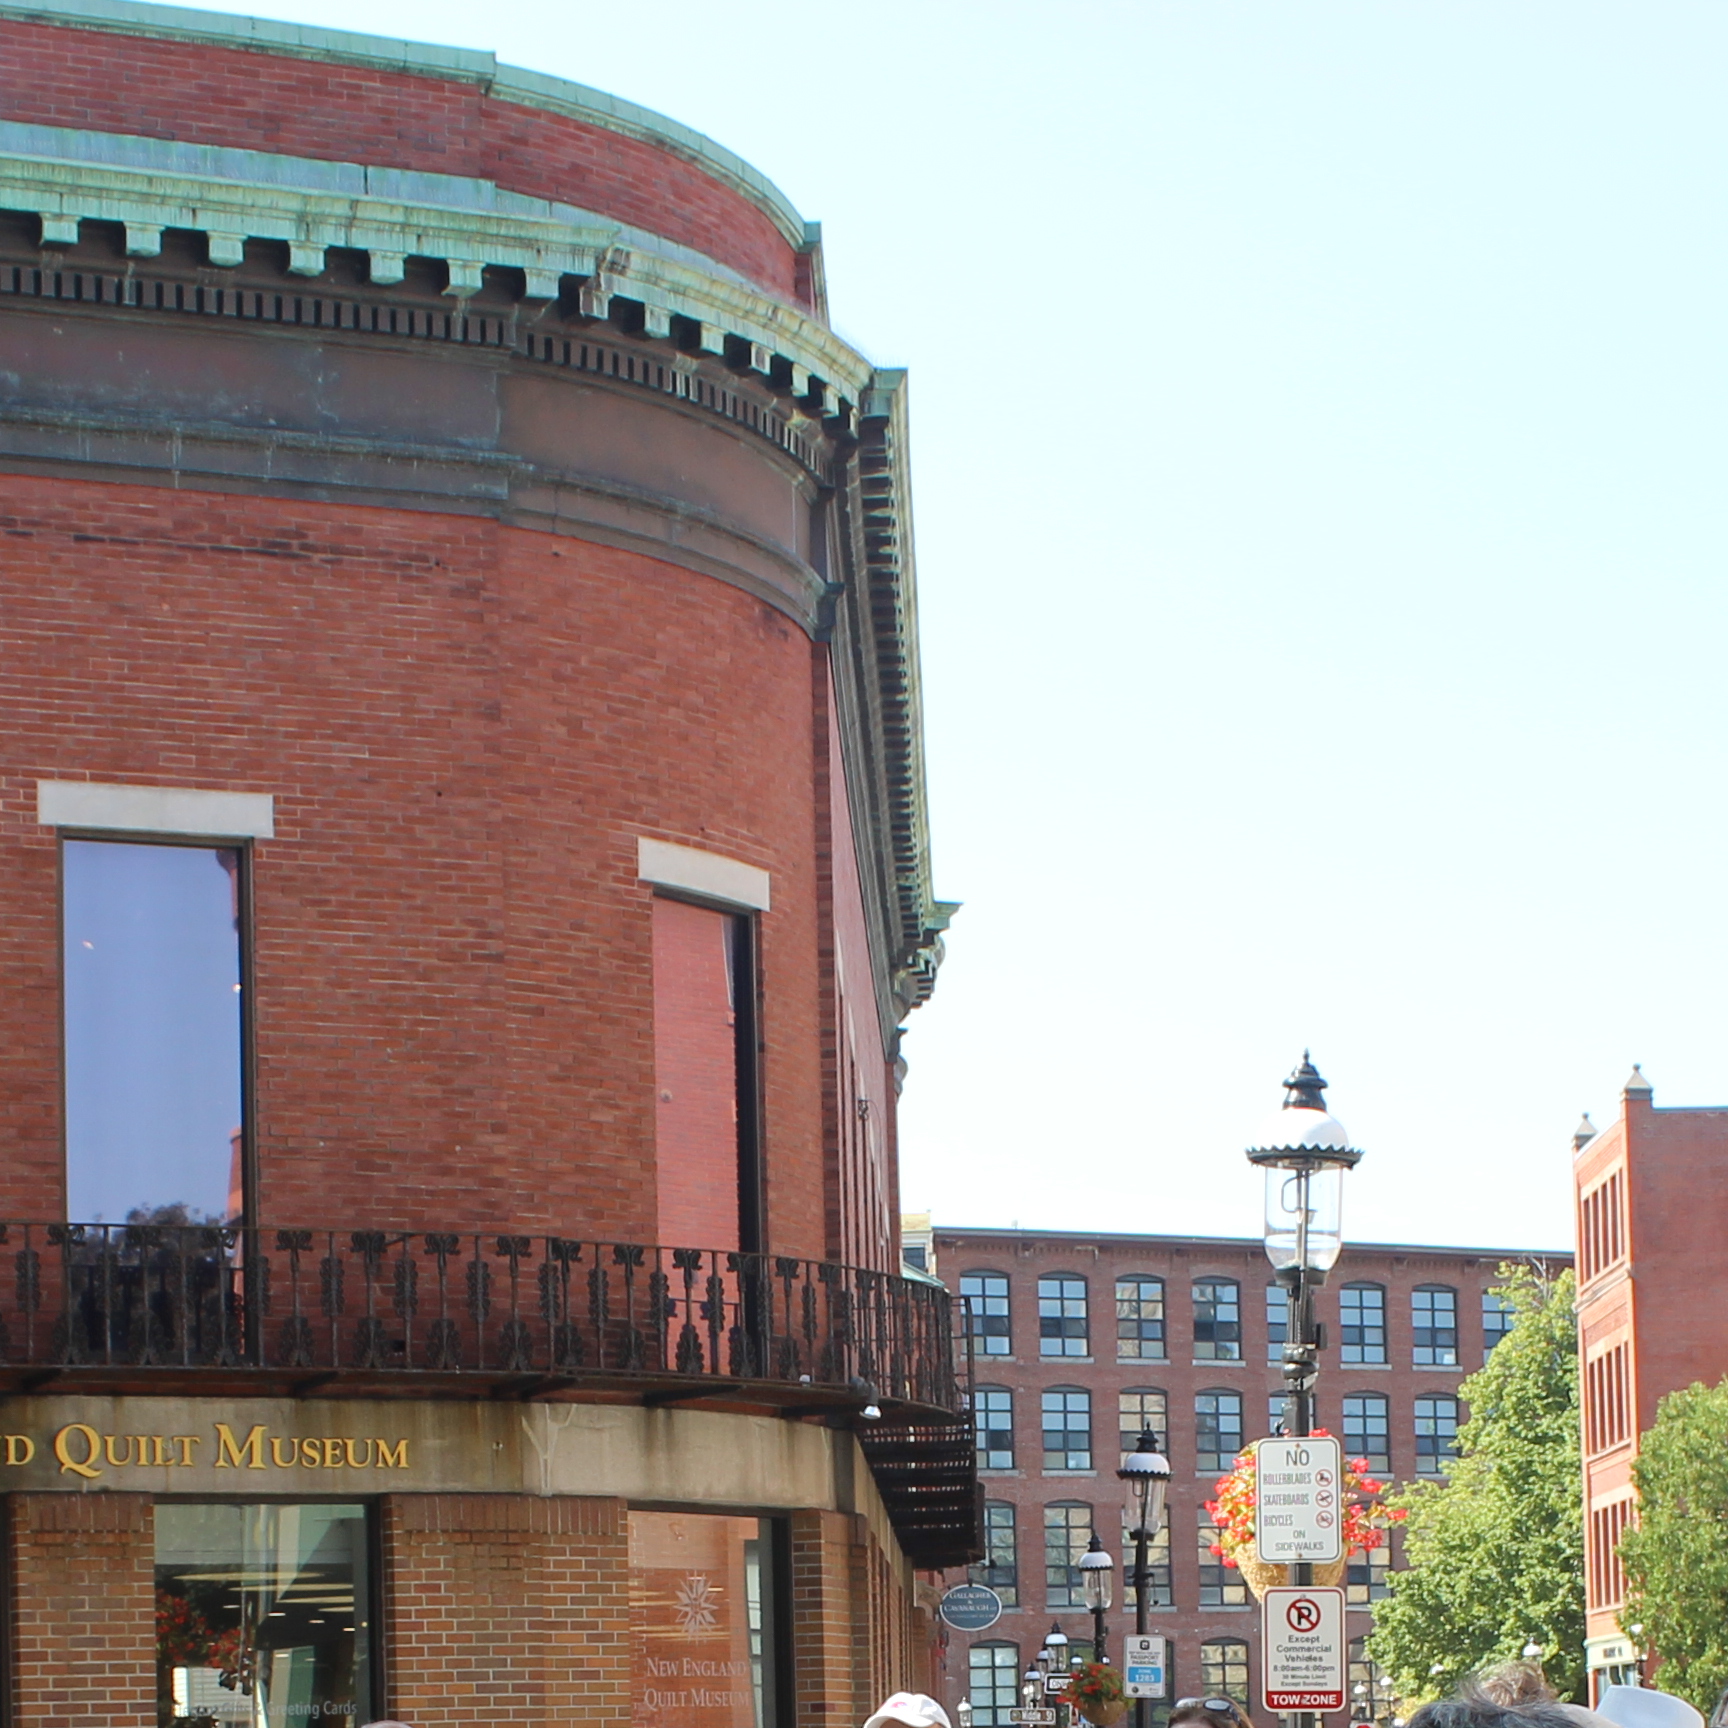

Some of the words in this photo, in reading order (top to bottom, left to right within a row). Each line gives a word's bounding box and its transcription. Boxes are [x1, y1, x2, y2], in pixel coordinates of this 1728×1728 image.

[1285, 1449, 1310, 1467] NO
[1262, 1472, 1312, 1486] ROLLERBLADES
[1263, 1493, 1309, 1506] SKATEBOARDS
[1263, 1514, 1293, 1527] BICYCLES
[1293, 1530, 1306, 1539] ON
[1275, 1541, 1324, 1551] SIDEWALKS
[1288, 1635, 1320, 1645] Except
[1276, 1644, 1332, 1653] Commercial
[1284, 1654, 1324, 1663] Vehicles
[1272, 1694, 1300, 1705] TOW
[1304, 1694, 1337, 1705] ZONE
[267, 1702, 320, 1719] Greeting
[324, 1700, 358, 1716] Cards
